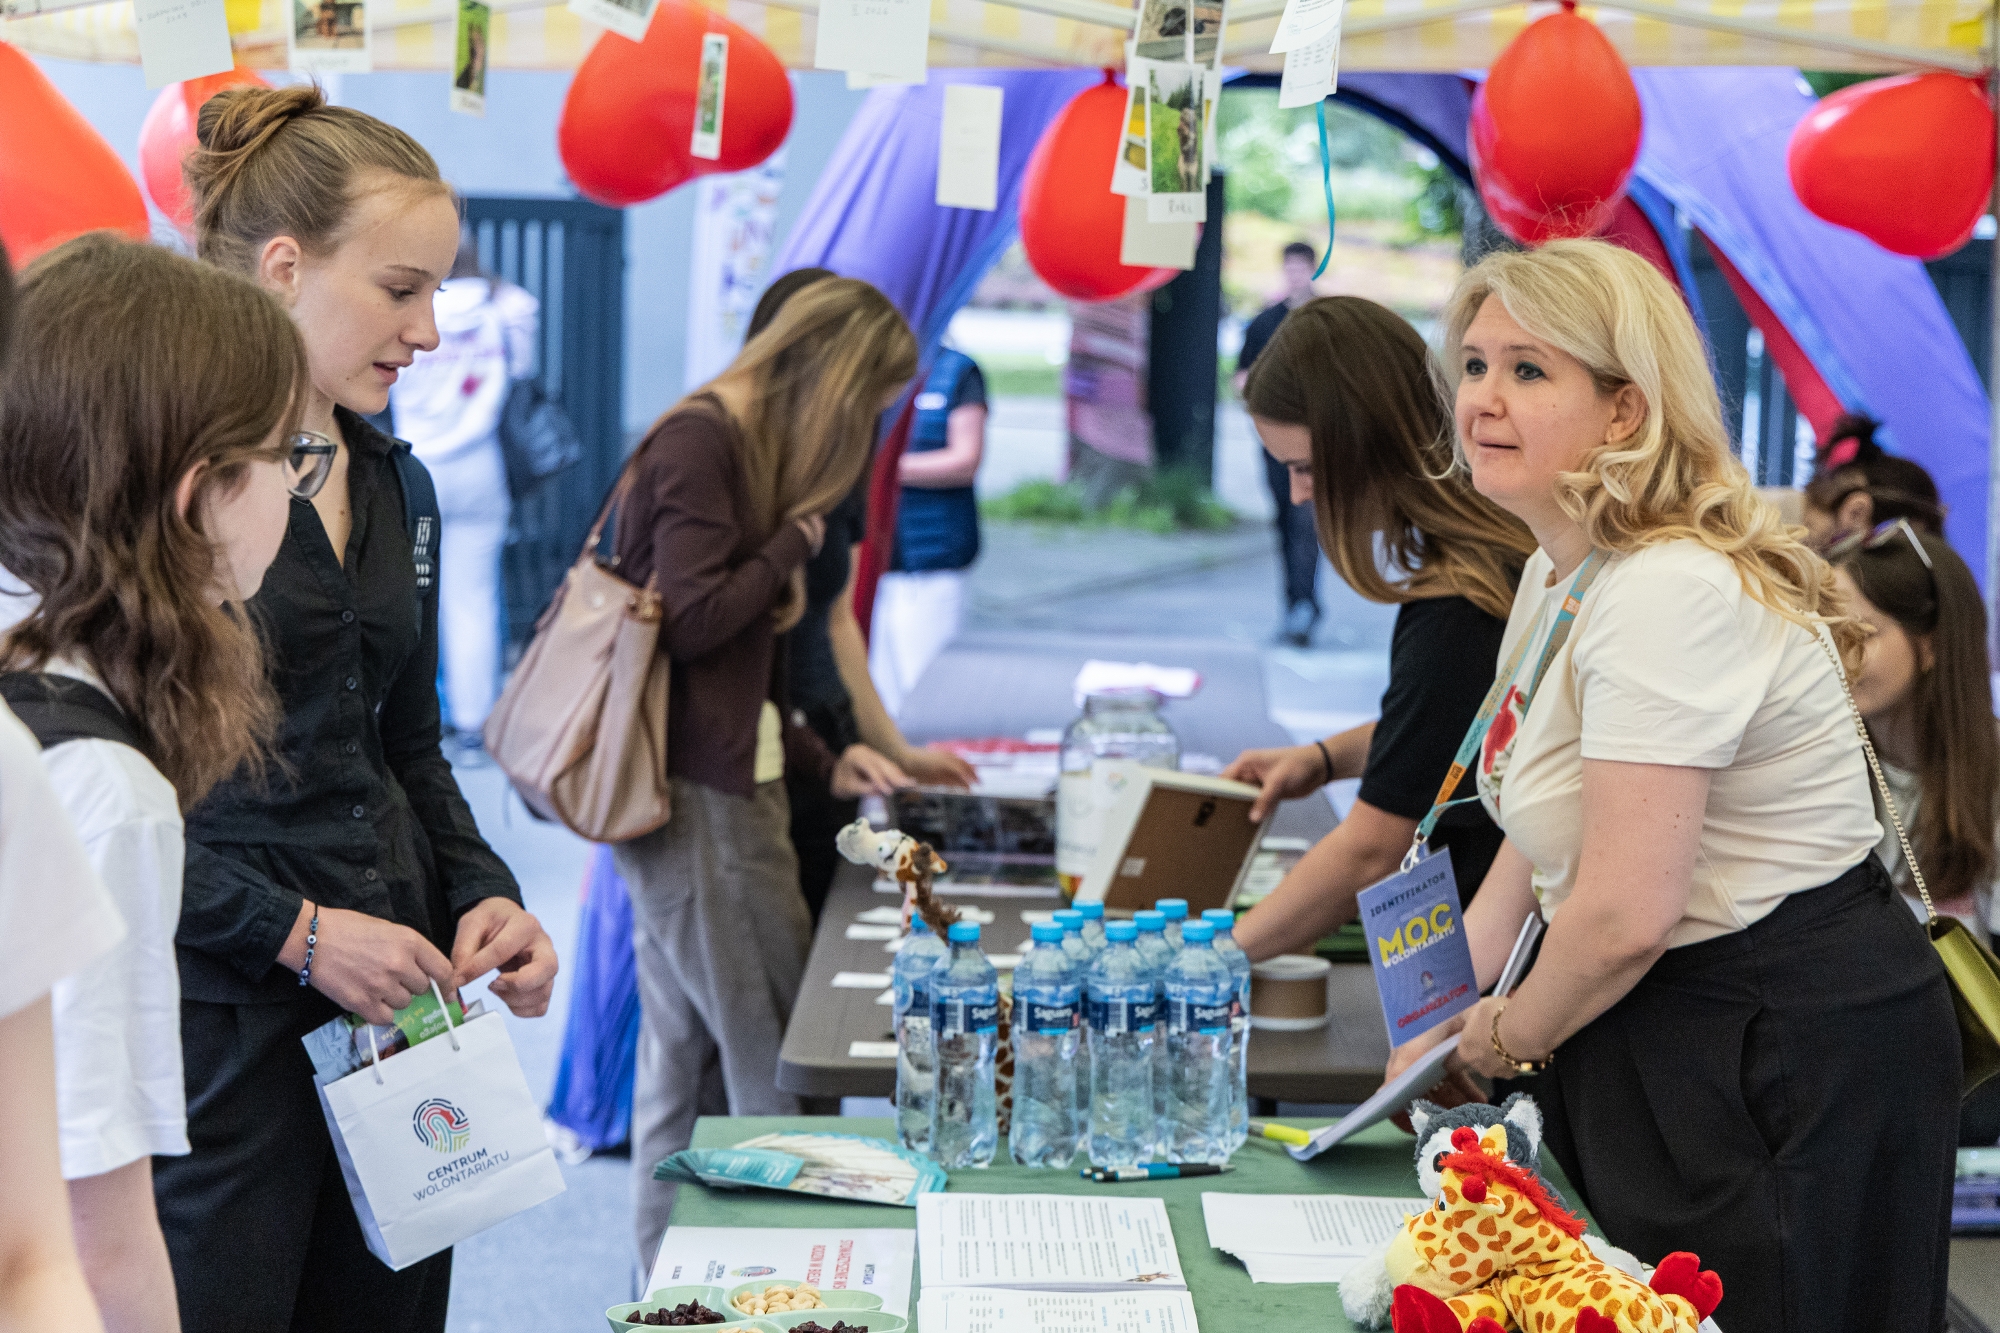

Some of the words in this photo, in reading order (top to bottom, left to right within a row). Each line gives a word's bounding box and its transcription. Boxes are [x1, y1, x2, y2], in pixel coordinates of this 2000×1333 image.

[1370, 871, 1446, 917] IDENTYFIKATOR
[1377, 903, 1453, 962] MOC
[1382, 924, 1456, 970] WOLONTARIATU
[1397, 983, 1469, 1029] ORGANIZATOR
[413, 1150, 510, 1201] WOLONTARIATU
[427, 1147, 488, 1182] CENTRUM
